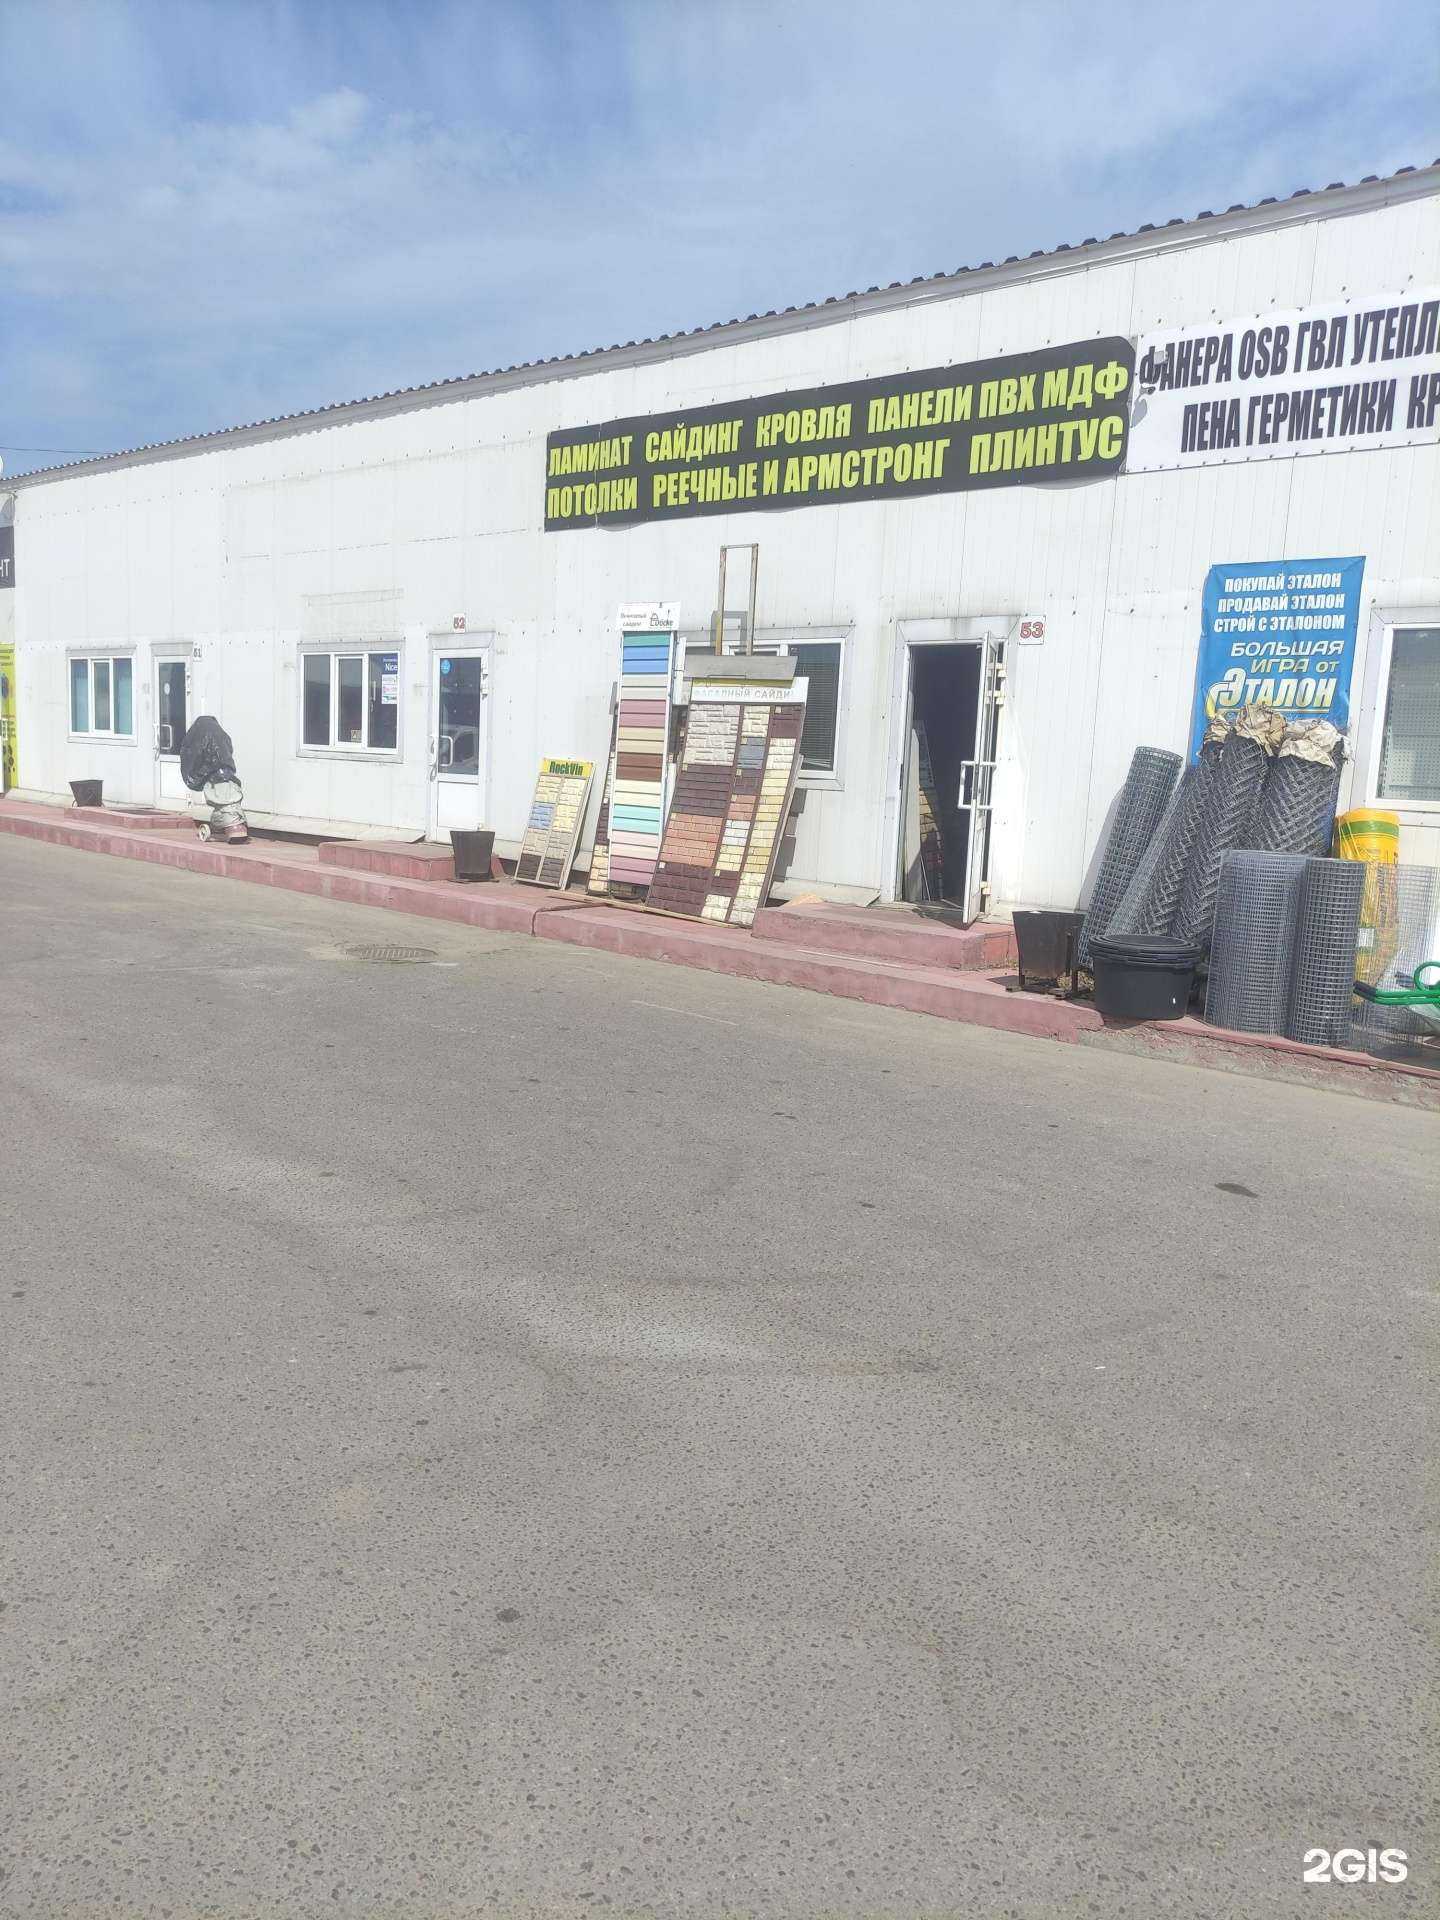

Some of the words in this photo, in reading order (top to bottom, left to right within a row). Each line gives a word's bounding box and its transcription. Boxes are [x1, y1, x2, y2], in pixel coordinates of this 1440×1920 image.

[1237, 325, 1290, 380] OSB
[1293, 315, 1349, 373] ГВЛ
[1350, 300, 1440, 367] УТЕПЛ
[547, 435, 633, 477] ЛАМИНАТ
[645, 420, 744, 464] САЙДИНГ
[755, 403, 852, 448] КРОВЛЯ
[867, 383, 973, 434] ПАНЕЛИ
[978, 371, 1036, 417] ПВХ
[1041, 360, 1129, 411] МДФ
[1181, 398, 1241, 453] ПЕНА
[1246, 378, 1397, 446] ГЕРМЕТИКИ
[546, 475, 638, 519] ПОТОЛКИ
[652, 457, 758, 507] РЕЕЧНЫЕ
[761, 454, 781, 496] И
[782, 439, 951, 493] АРМСТРОНГ
[969, 415, 1125, 475] ПЛИНТУС
[1224, 573, 1284, 593] ПОКУПАЙ
[1287, 573, 1342, 590] ЭТАЛОН
[1218, 594, 1288, 613] ПРОДАВАЙ
[1291, 593, 1345, 610] ЭТАЛОН
[453, 616, 465, 629] 52
[1019, 621, 1044, 639] 53
[1214, 615, 1255, 633] СТРОЙ
[1258, 617, 1267, 632] С
[1269, 615, 1345, 632] ЭТАЛОНОМ
[1230, 640, 1345, 657] БОЛЬШАЯ
[1250, 658, 1310, 674] ИГРА
